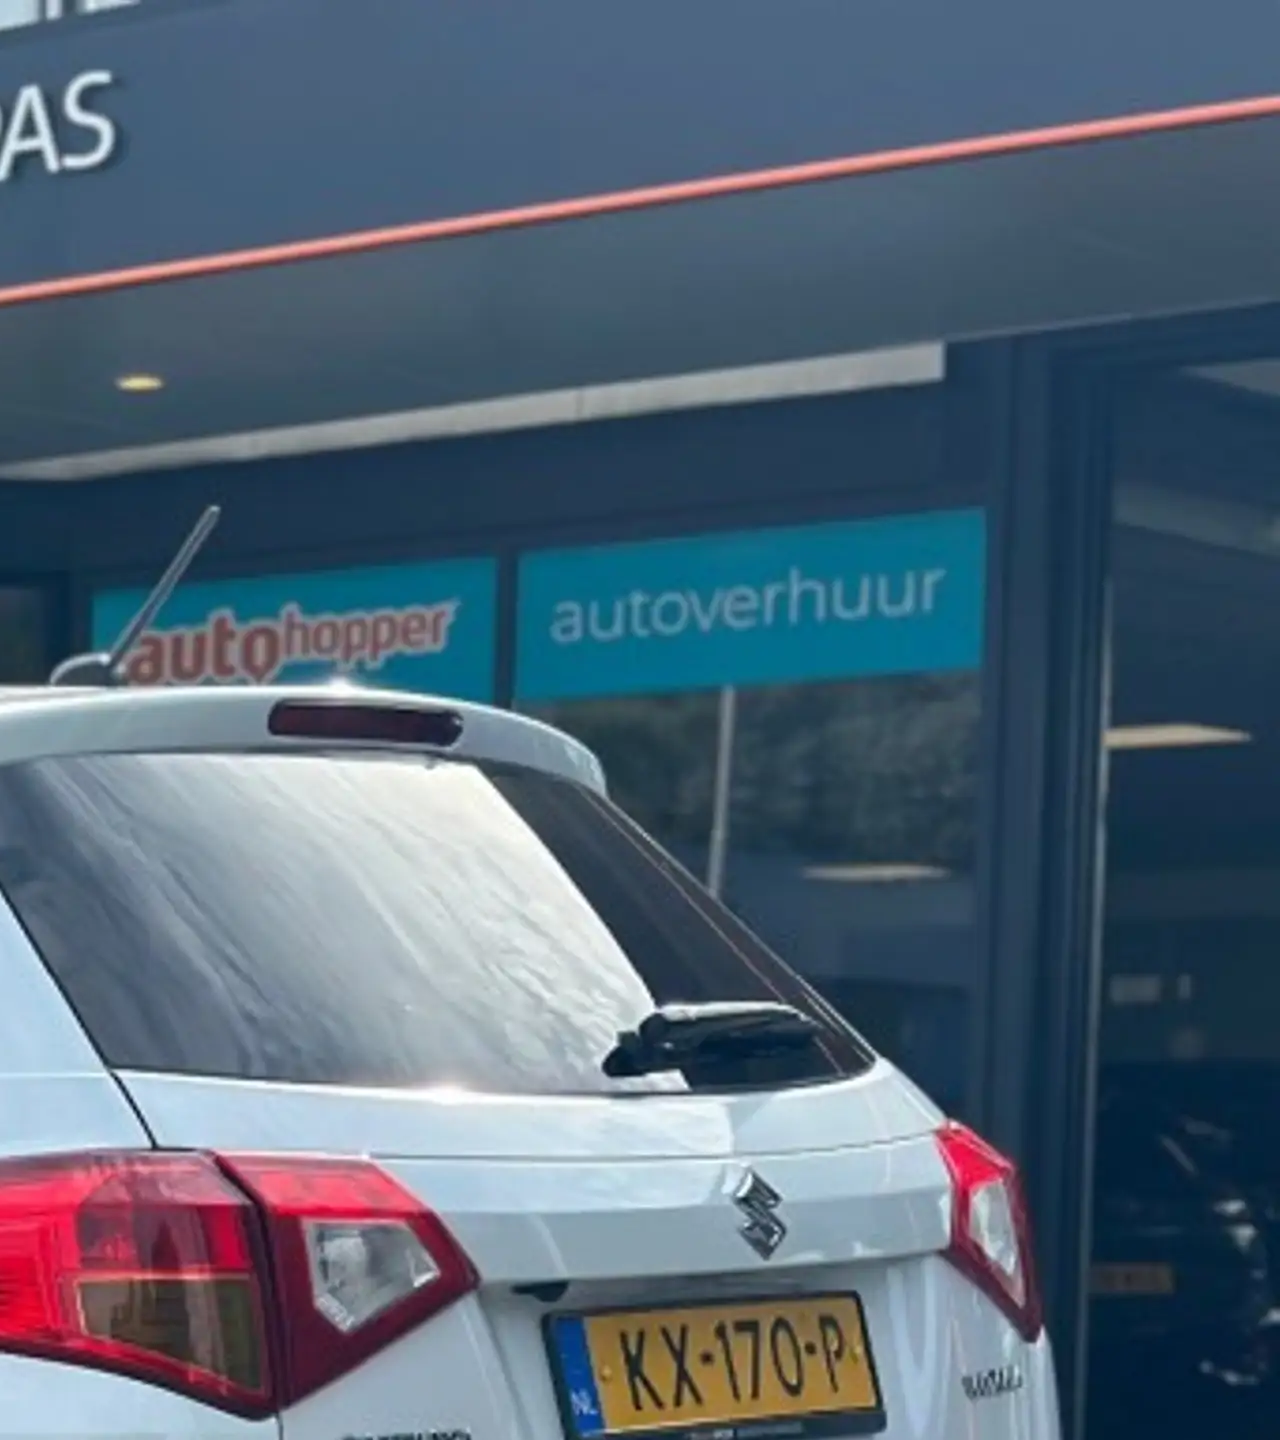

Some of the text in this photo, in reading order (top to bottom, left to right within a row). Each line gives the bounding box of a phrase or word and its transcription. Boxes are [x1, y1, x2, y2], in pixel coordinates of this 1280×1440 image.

[124, 598, 458, 686] autohopper
[548, 564, 948, 646] autoverhuur
[620, 1312, 846, 1412] KX-170-P
